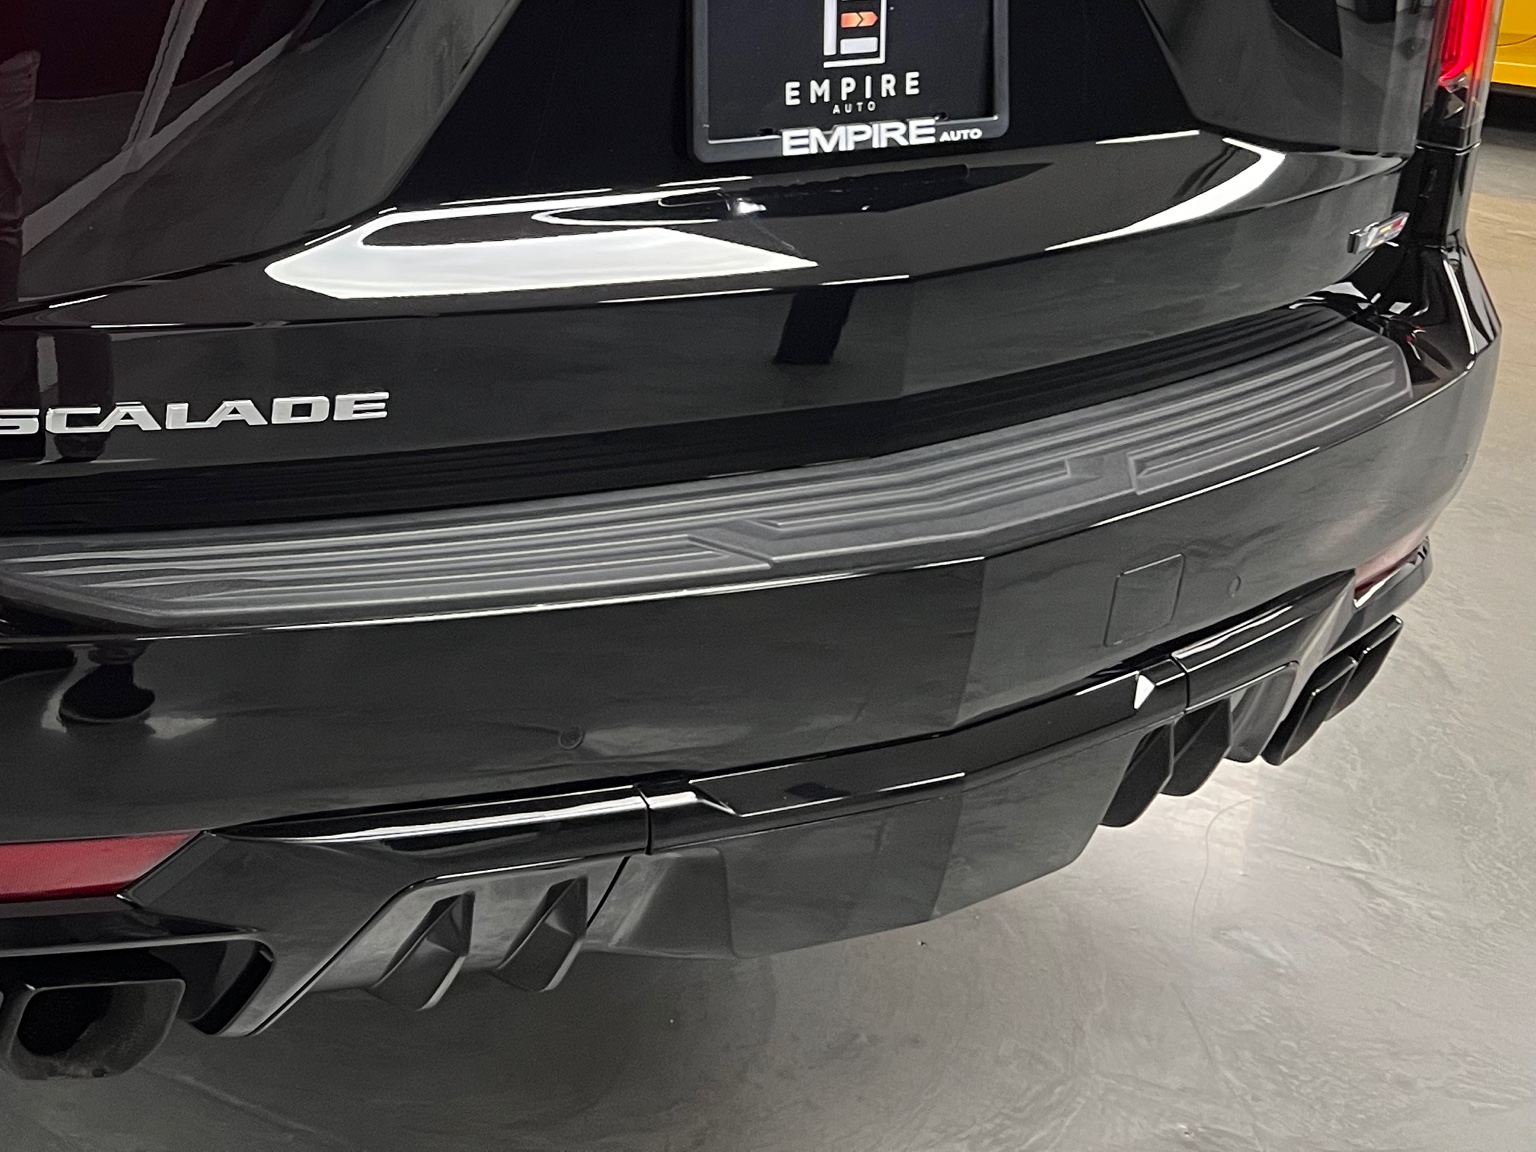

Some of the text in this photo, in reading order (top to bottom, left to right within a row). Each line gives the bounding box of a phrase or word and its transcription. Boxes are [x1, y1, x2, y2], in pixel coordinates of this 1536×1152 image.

[785, 71, 920, 106] EMPIRE
[831, 100, 877, 115] AUTO
[781, 118, 983, 157] EMPIRE AUTO
